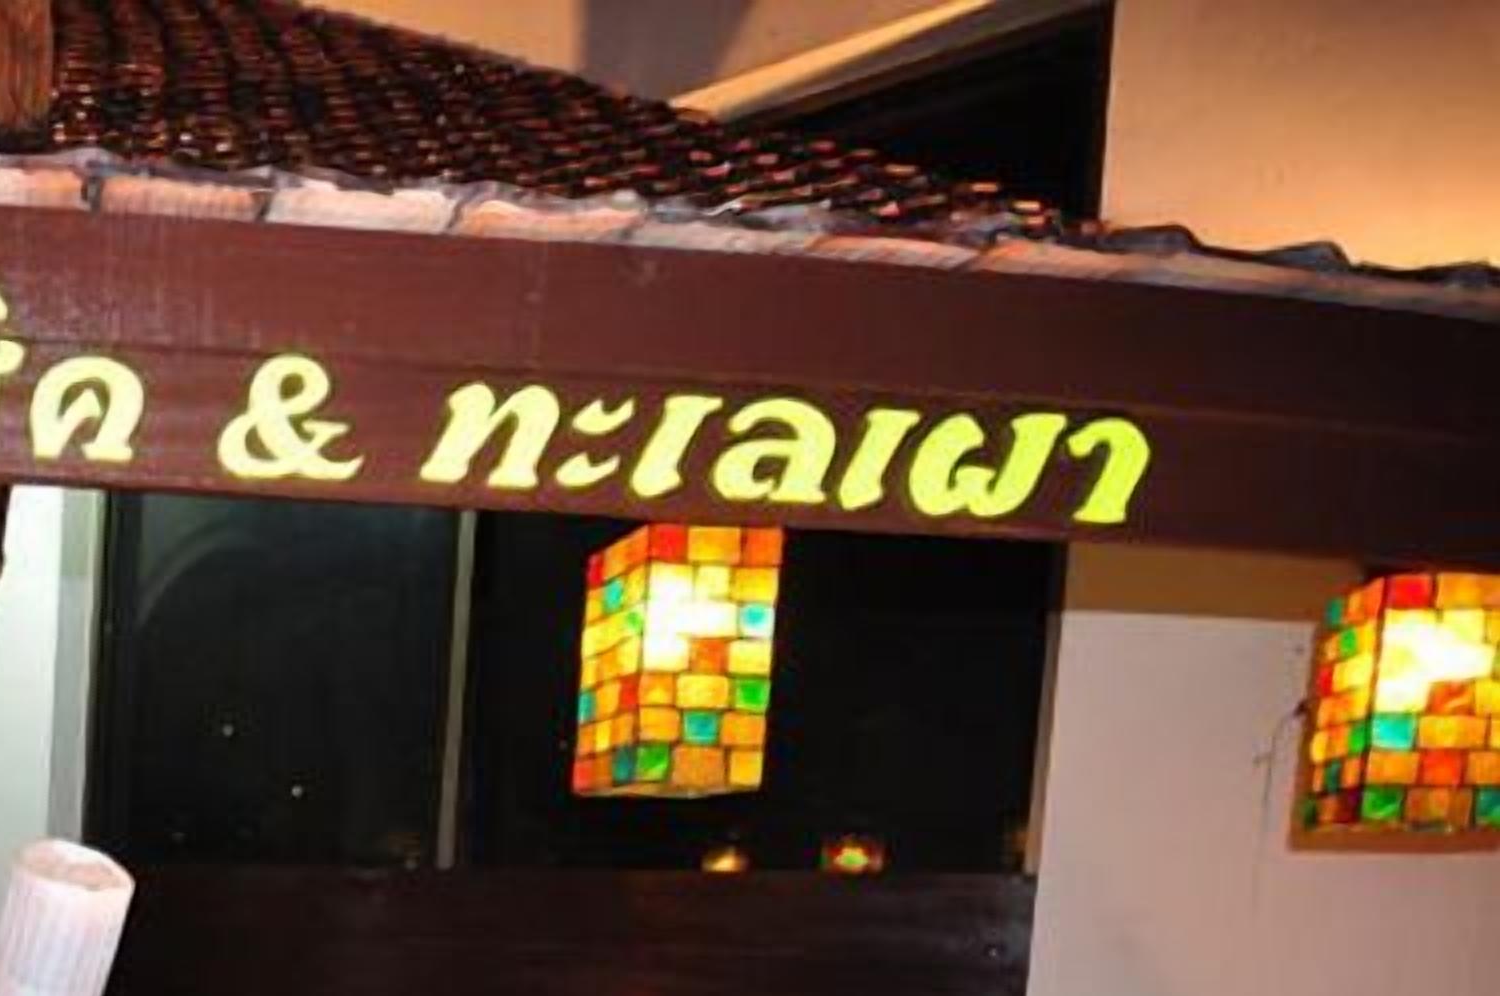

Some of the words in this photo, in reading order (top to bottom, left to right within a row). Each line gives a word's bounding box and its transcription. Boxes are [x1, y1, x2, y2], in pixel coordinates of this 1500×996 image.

[217, 354, 364, 481] &
[419, 381, 1151, 524] ทะเลเผา
